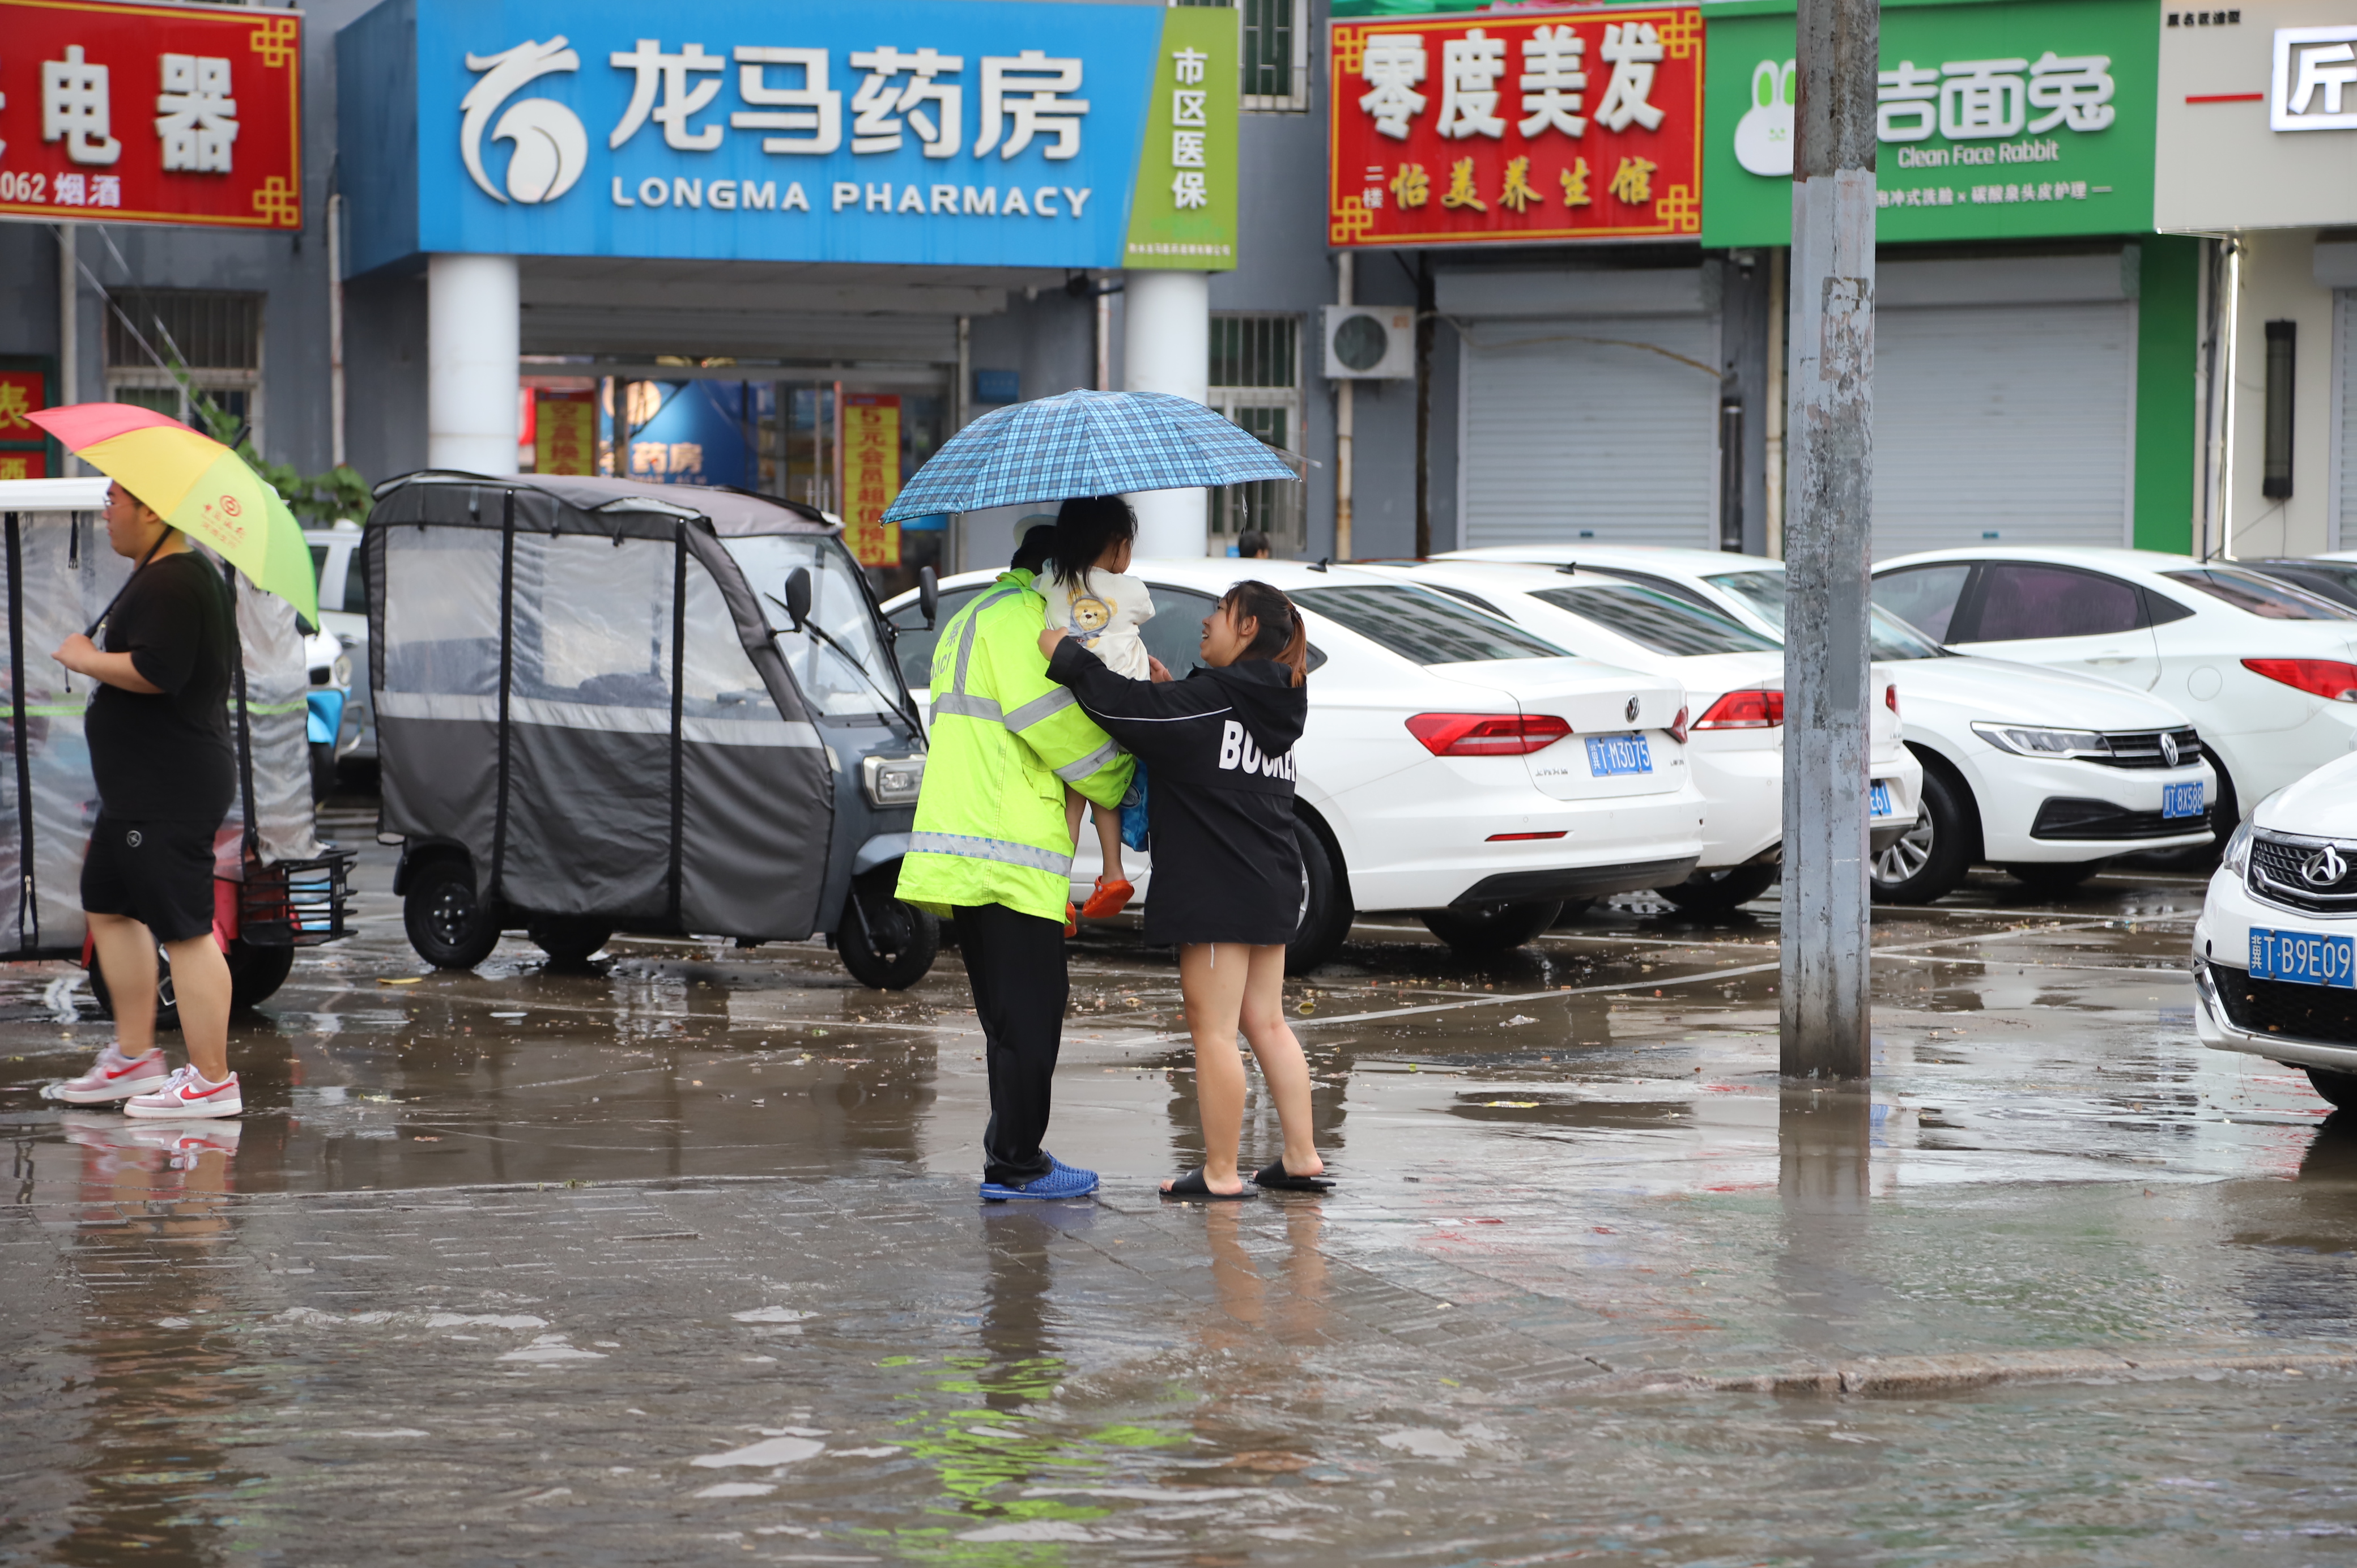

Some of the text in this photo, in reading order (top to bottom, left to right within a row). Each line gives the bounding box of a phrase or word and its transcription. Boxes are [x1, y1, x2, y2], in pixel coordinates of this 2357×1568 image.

[0, 45, 239, 174] 电器
[609, 39, 1091, 159] 龙马药房
[1359, 22, 1665, 139] 零度美发
[1171, 46, 1209, 210] 市区医保
[1897, 139, 2060, 169] Clean Face Rabbit
[53, 172, 121, 207] 烟酒
[612, 176, 1092, 218] LONGMA PHARMACY
[1389, 155, 1658, 213] 怡美养生馆
[939, 619, 964, 647] 察
